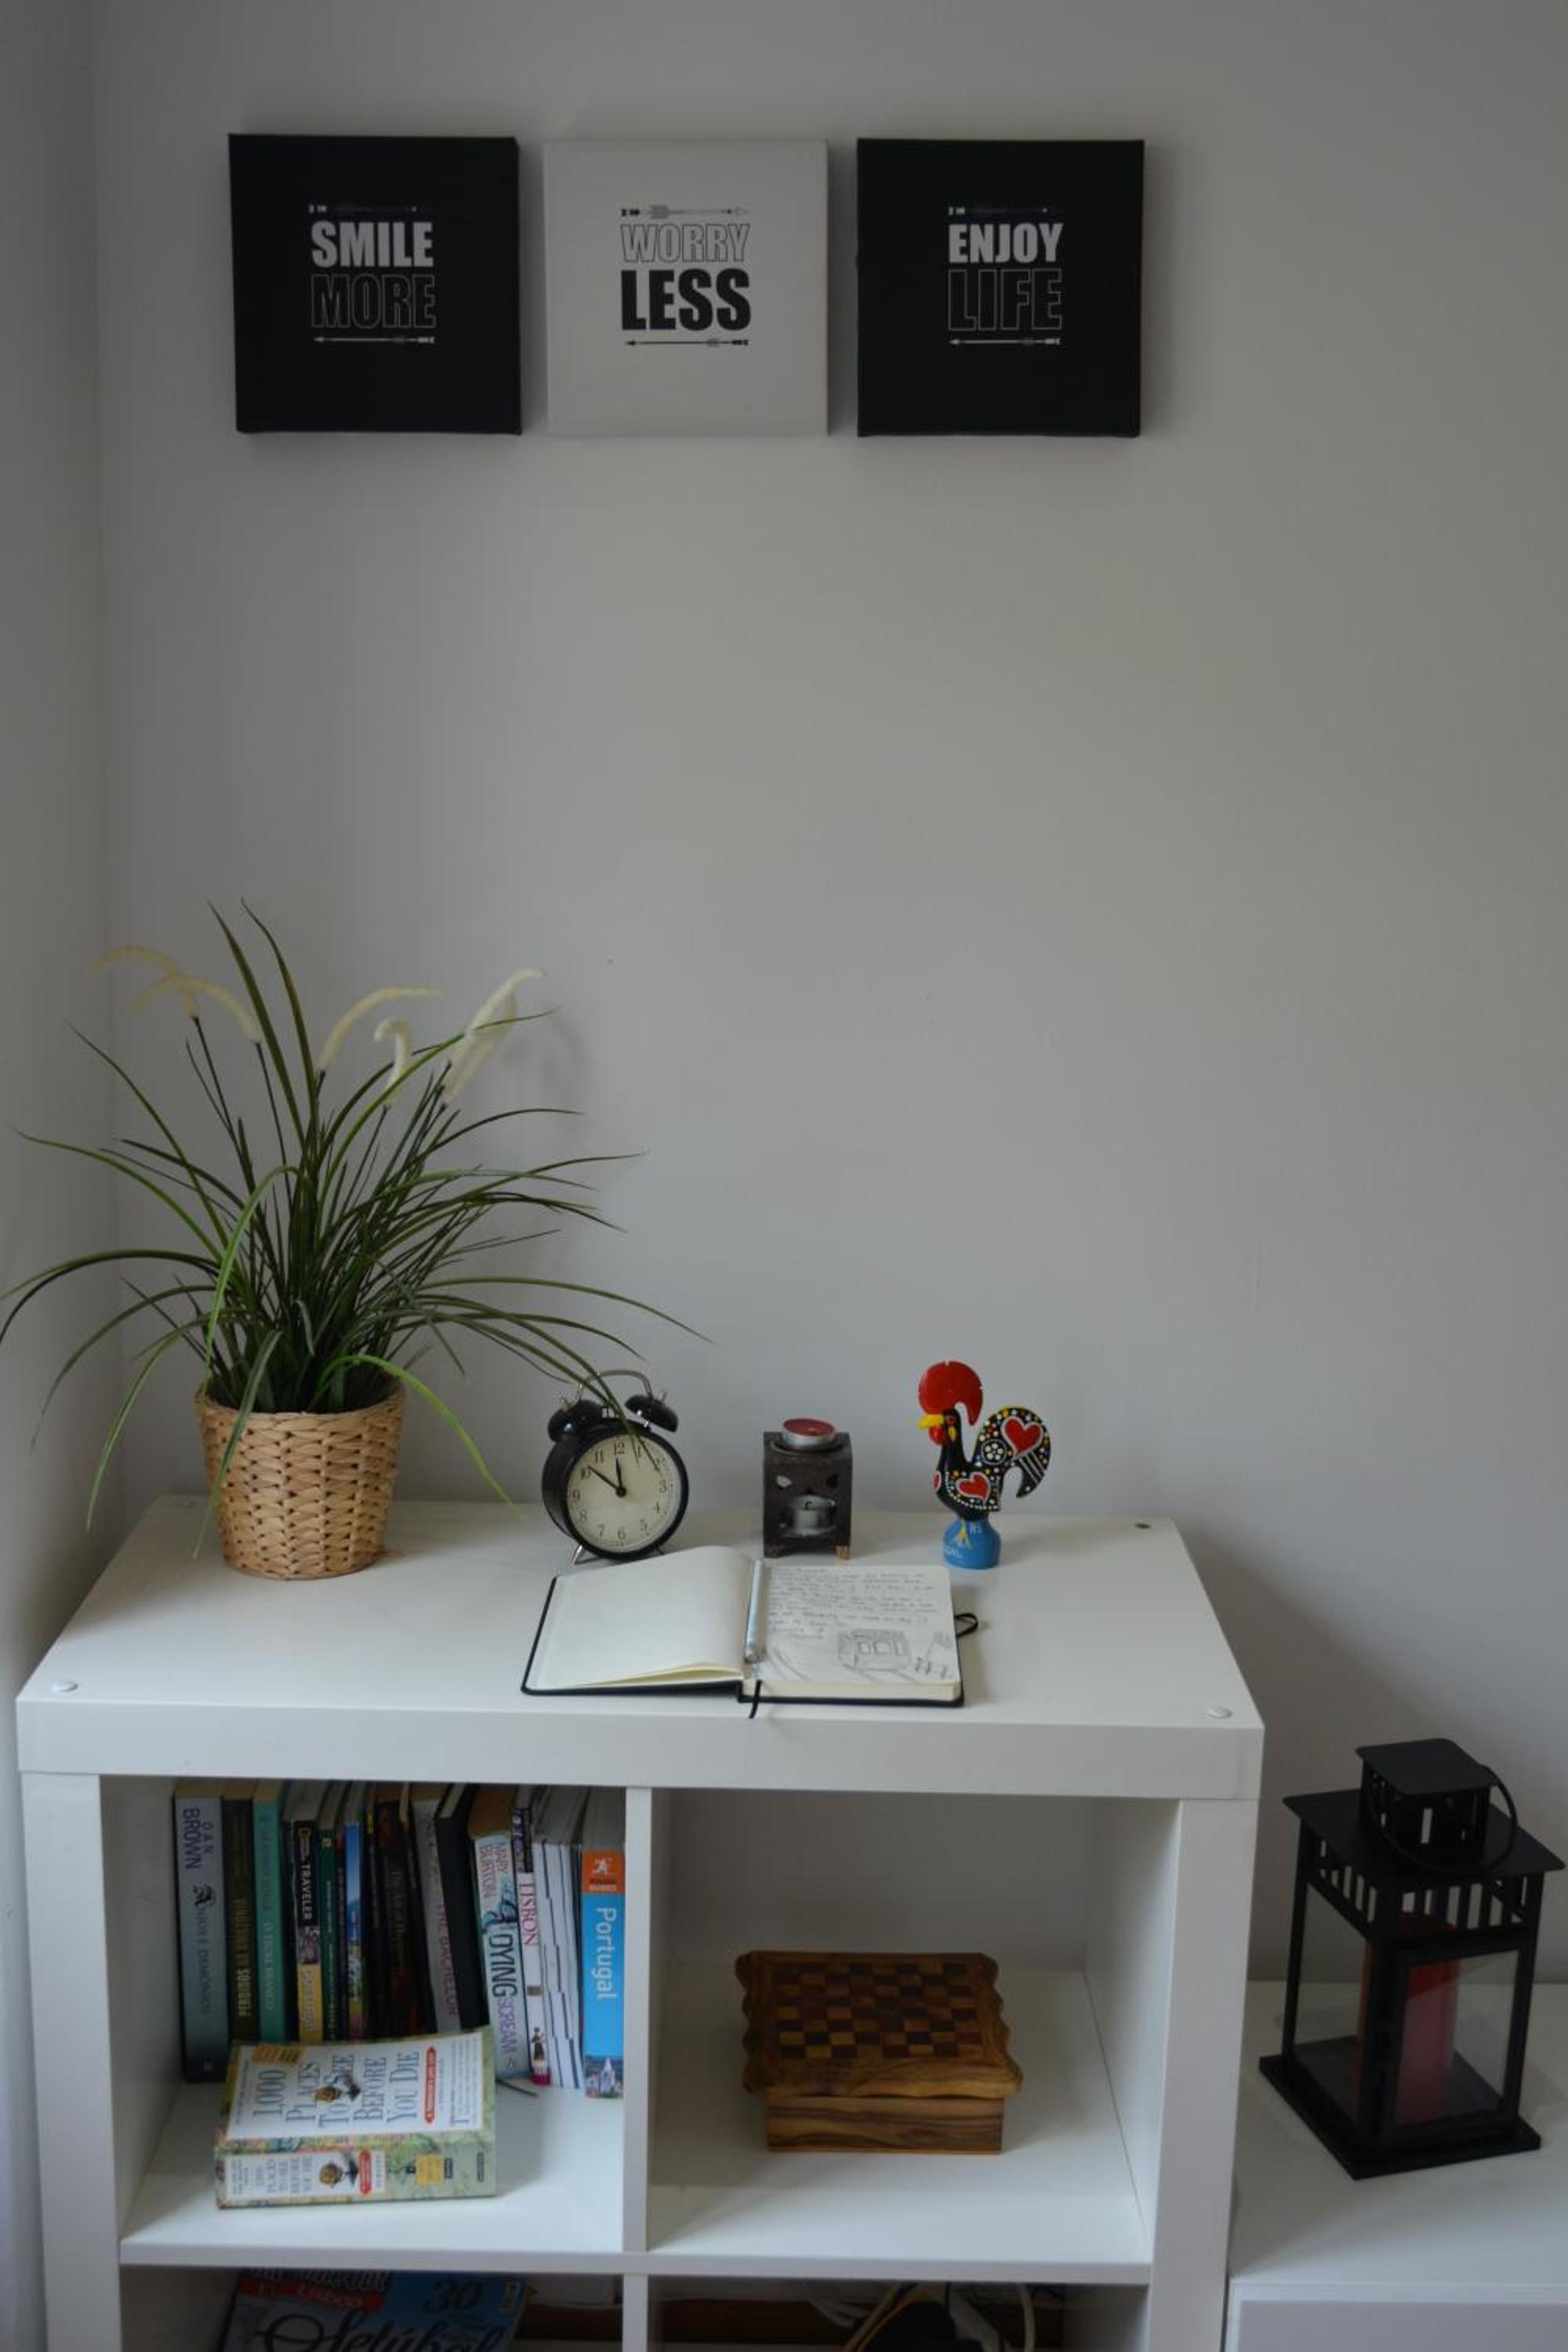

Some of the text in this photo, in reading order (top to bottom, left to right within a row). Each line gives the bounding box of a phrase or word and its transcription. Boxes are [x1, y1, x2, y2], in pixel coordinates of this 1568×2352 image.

[311, 220, 434, 268] SMILE
[620, 223, 750, 263] WORRY
[949, 223, 1064, 263] ENJOY
[311, 273, 437, 328] MORE
[621, 268, 751, 330] LESS
[949, 268, 1062, 331] LIFE
[594, 1450, 604, 1464] 11
[614, 1442, 626, 1454] 12
[572, 1490, 581, 1502] 9
[653, 1502, 660, 1514] 4
[659, 1479, 667, 1494] 3
[579, 1508, 587, 1521] 8
[597, 1524, 605, 1537] 7
[617, 1526, 626, 1539] 6
[182, 1808, 201, 1869] BROWN
[201, 1821, 213, 1855] DAN
[494, 1842, 507, 1875] MARY
[300, 1863, 313, 1920] TRAVELER
[478, 1845, 495, 1899] BURTON
[518, 1882, 539, 1946] LISBON
[590, 1907, 617, 2000] Portugal
[488, 1933, 518, 2056] DYING SCREAM
[252, 2069, 287, 2115] 1,000
[285, 2061, 320, 2121] PLACES
[318, 2054, 354, 2128] TO SEE
[353, 2056, 387, 2120] BEFORE
[387, 2051, 419, 2124] YOU DIE
